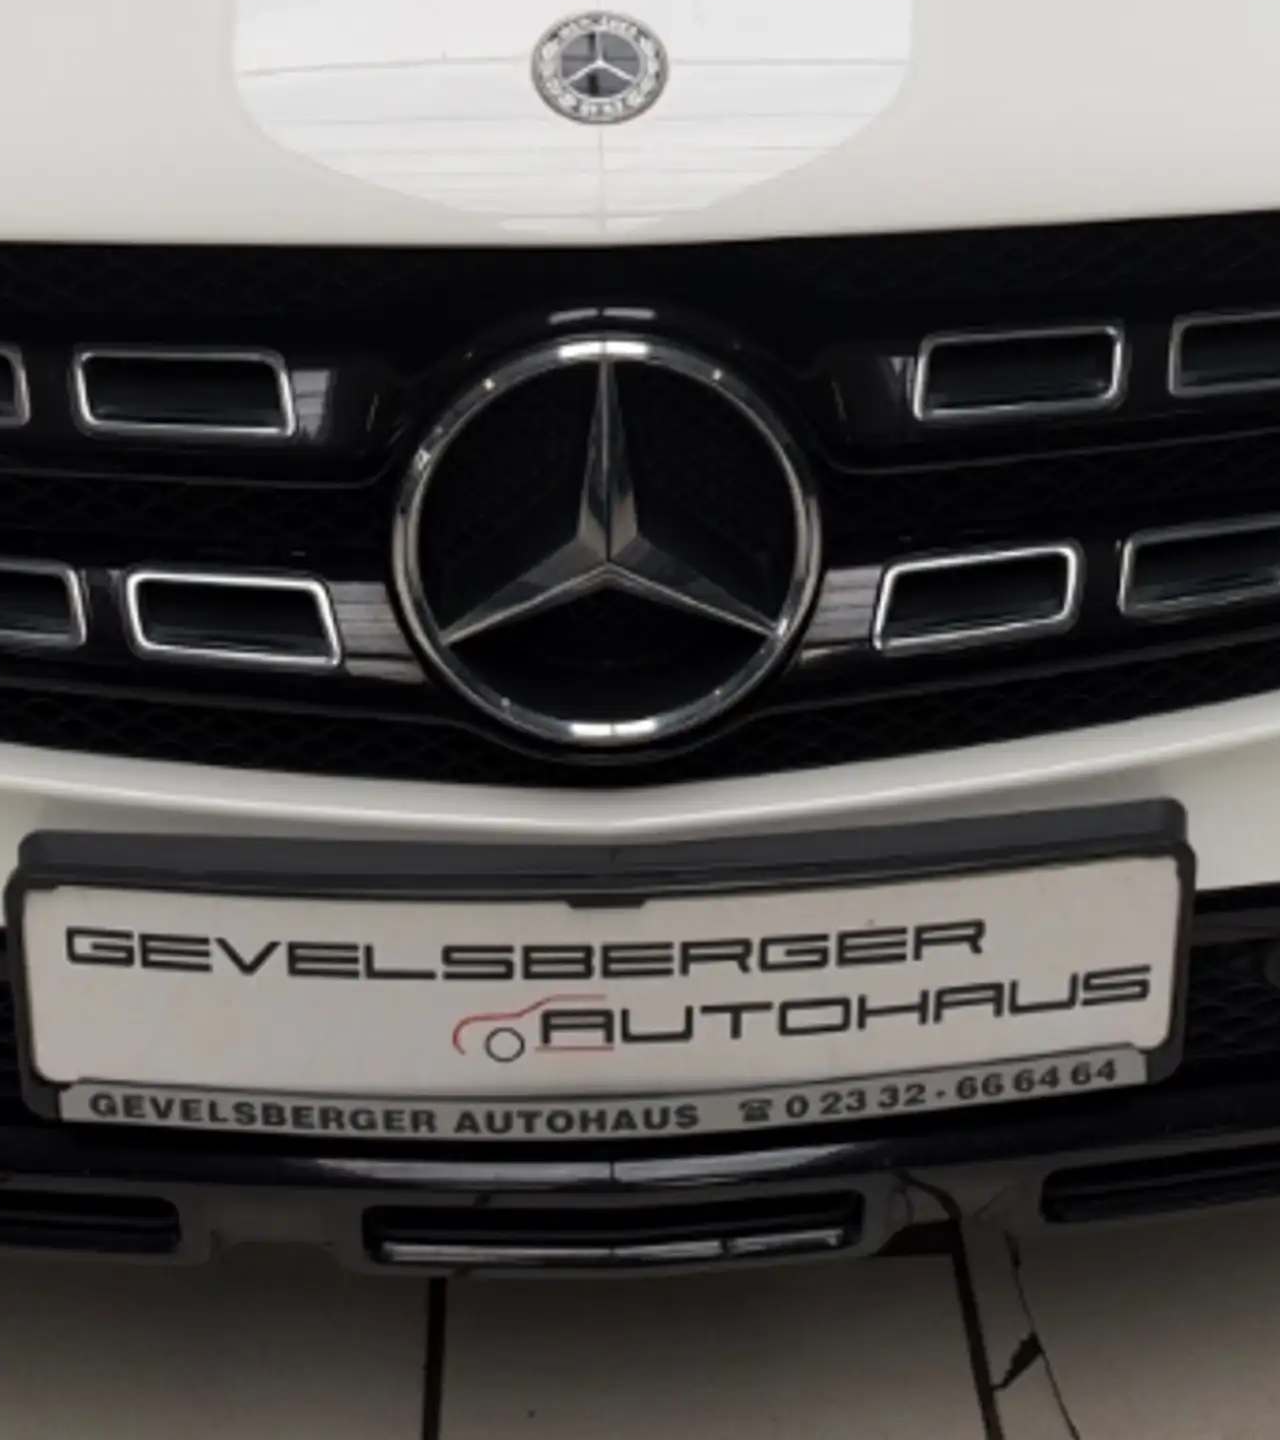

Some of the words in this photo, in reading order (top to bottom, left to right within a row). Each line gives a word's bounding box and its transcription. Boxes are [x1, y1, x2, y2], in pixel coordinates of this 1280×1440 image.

[65, 919, 986, 980] GEVELSBERGER
[540, 965, 1152, 1046] AUTOHAUS
[88, 1092, 436, 1135] GEVELSBERGER
[454, 1104, 701, 1136] AUTOHAUS
